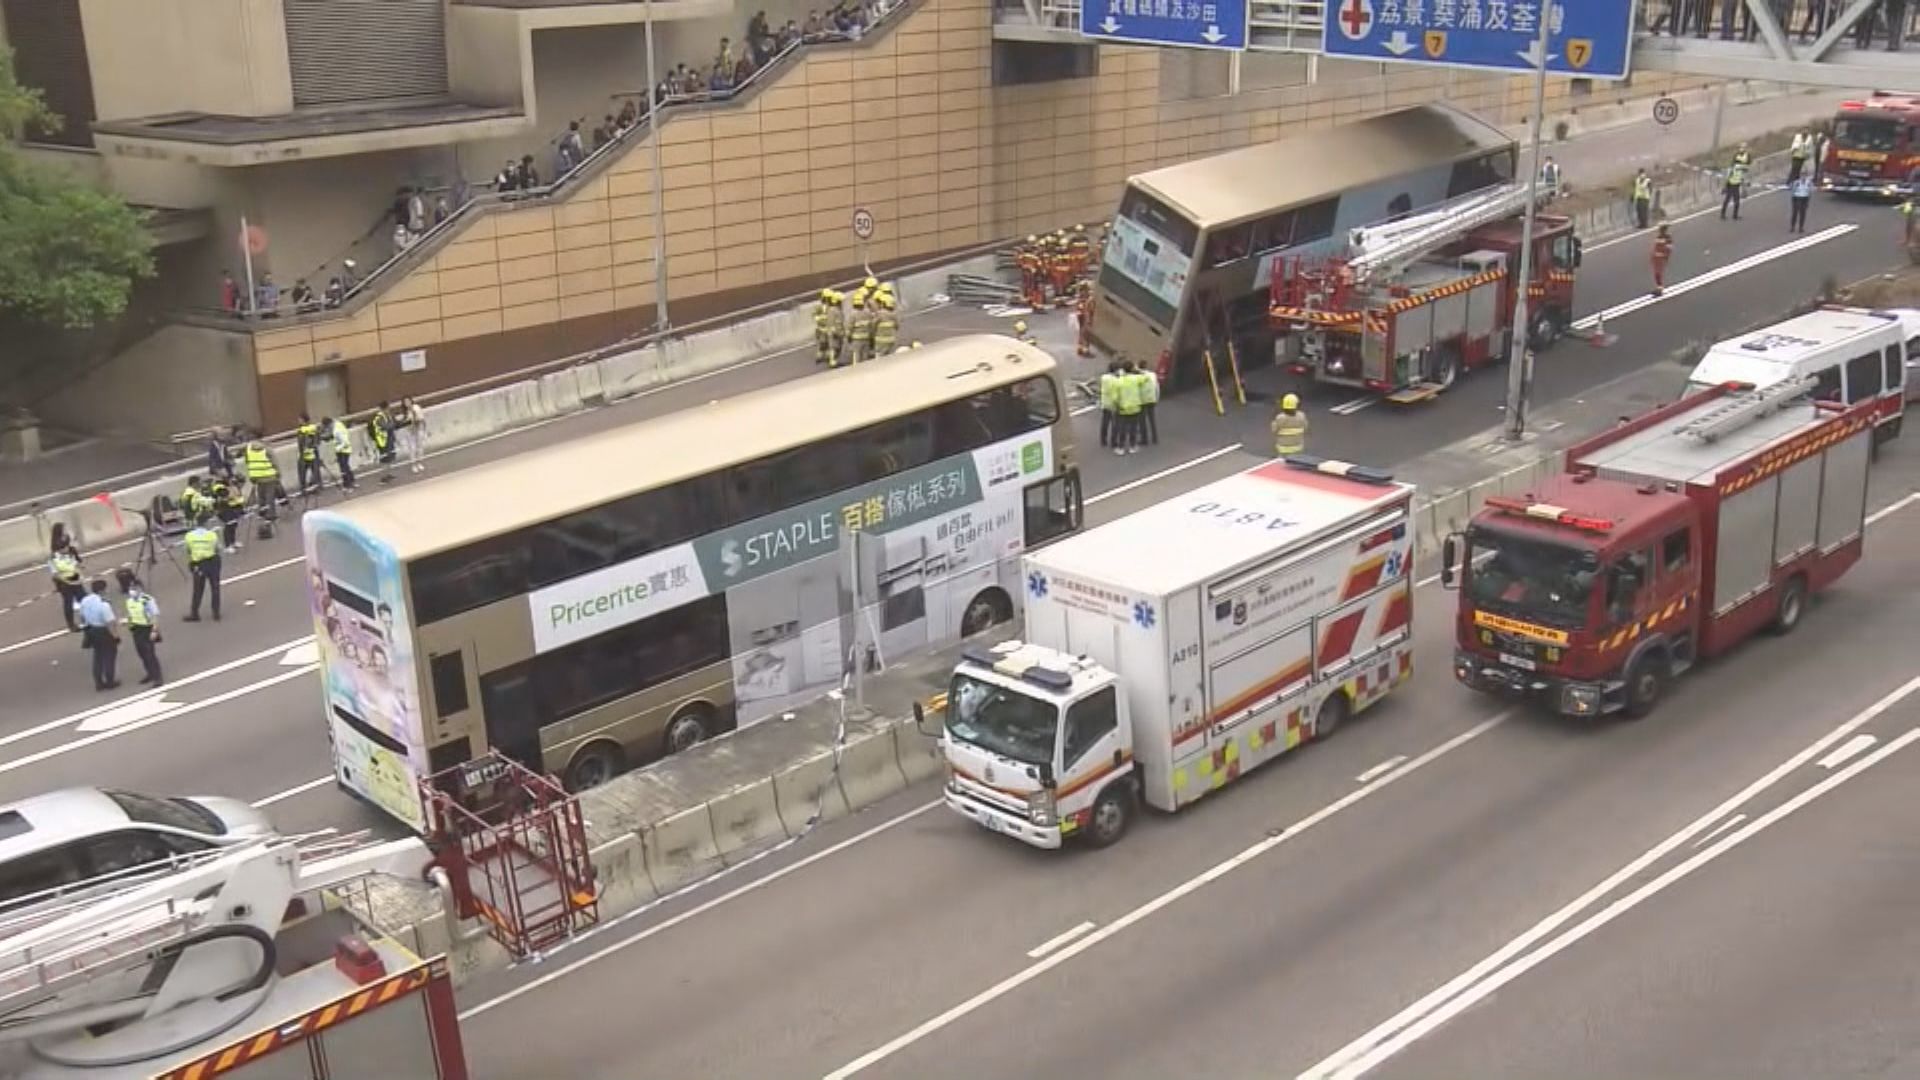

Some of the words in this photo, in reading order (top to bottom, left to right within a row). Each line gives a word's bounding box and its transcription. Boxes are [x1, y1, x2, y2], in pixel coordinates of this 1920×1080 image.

[1431, 36, 1441, 52] 7
[1575, 46, 1585, 62] 7
[1658, 106, 1674, 118] 70
[857, 218, 870, 230] 50
[745, 512, 834, 566] STAPLE
[551, 582, 648, 629] Pricerite
